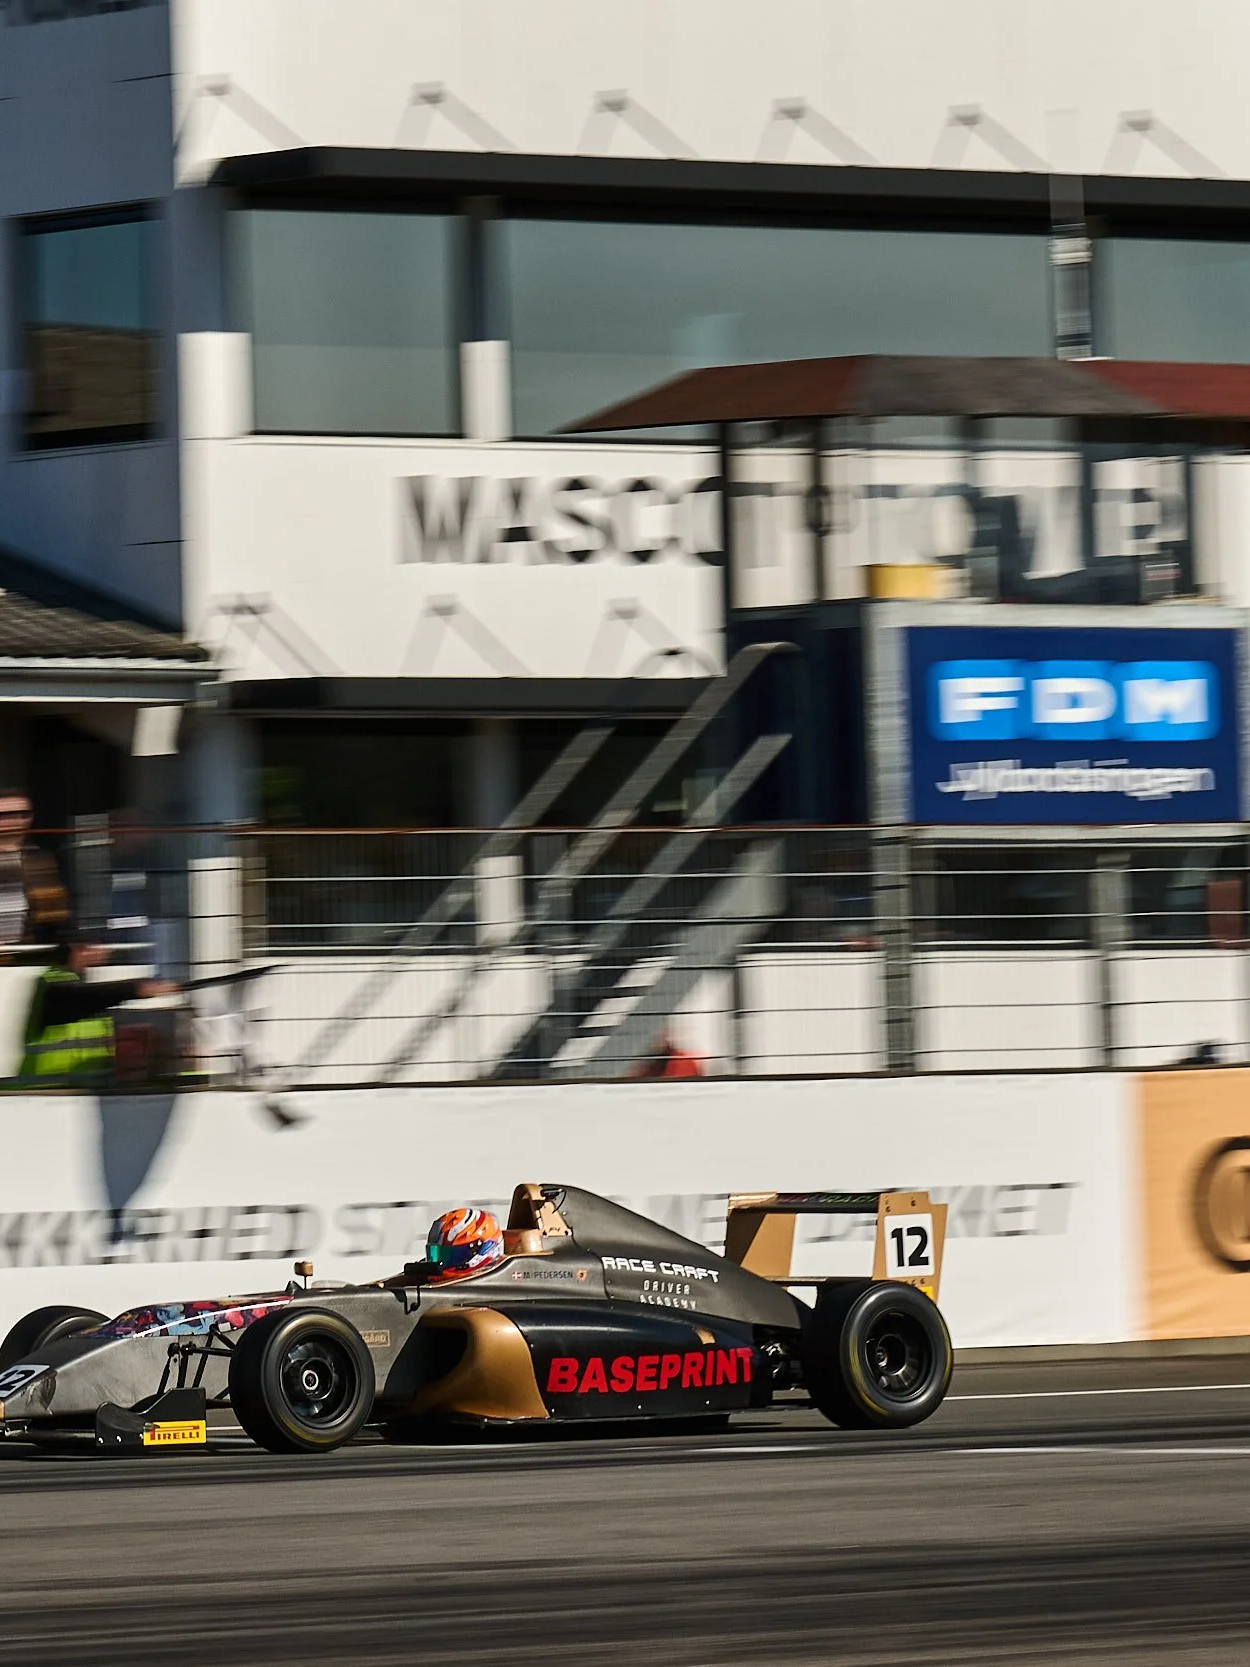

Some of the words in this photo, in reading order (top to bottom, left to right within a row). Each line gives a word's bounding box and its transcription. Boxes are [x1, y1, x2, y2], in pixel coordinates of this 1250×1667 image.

[938, 677, 1209, 724] FDM
[891, 1226, 930, 1267] 12
[534, 1270, 574, 1280] PEDERSEN
[601, 1256, 657, 1273] RACE
[659, 1261, 720, 1283] CRAFT
[643, 1279, 691, 1295] DRIVER
[640, 1294, 697, 1310] ACADEMY
[546, 1347, 753, 1394] BASEPRINT
[148, 1424, 200, 1441] PIRELLI
